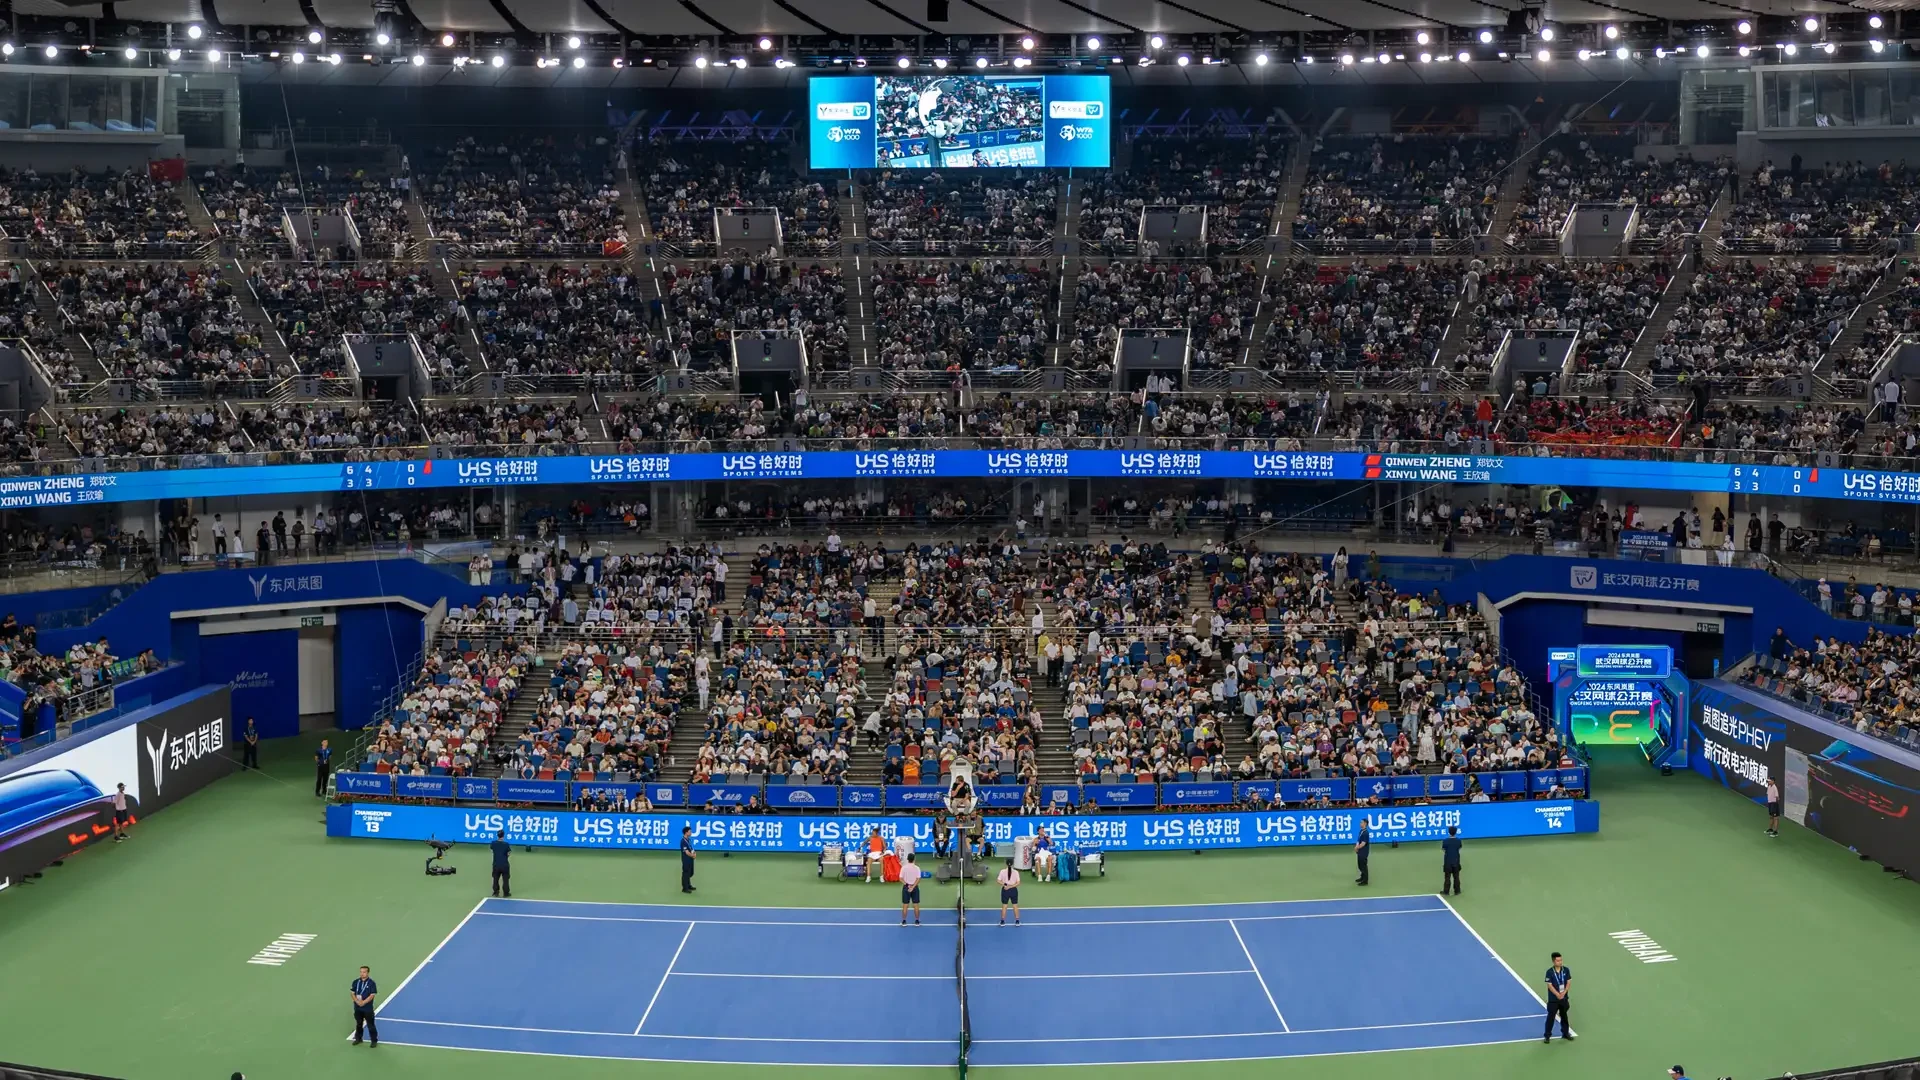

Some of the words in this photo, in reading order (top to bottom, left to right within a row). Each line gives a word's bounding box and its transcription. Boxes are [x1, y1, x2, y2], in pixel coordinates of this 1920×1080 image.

[312, 218, 319, 230] 5
[742, 218, 749, 230] 6
[1172, 216, 1178, 228] 7
[1602, 214, 1609, 227] 8
[375, 346, 382, 361] 5
[763, 342, 771, 355] 6
[1152, 340, 1159, 354] 7
[1538, 342, 1546, 356] 8
[491, 380, 497, 390] 5
[677, 377, 684, 388] 6
[864, 375, 871, 386] 6
[118, 387, 124, 397] 4
[305, 383, 311, 393] 5
[1797, 383, 1804, 393] 9
[783, 440, 790, 451] 6
[1133, 438, 1138, 449] 7
[1480, 443, 1486, 454] 8
[436, 447, 443, 458] 5
[90, 461, 97, 472] 4
[591, 458, 624, 473] UHS
[627, 457, 670, 472] 恰好时
[723, 456, 756, 470] UHS
[759, 455, 802, 469] 恰好时
[855, 454, 889, 468] UHS
[892, 454, 935, 468] 恰好时
[988, 453, 1022, 467] UHS
[1025, 453, 1068, 467] 恰好时
[1121, 453, 1155, 468] UHS
[1157, 454, 1201, 468] 恰好时
[1254, 454, 1288, 469] UHS
[1290, 455, 1333, 470] 恰好时
[1385, 457, 1427, 467] QINWEN
[1430, 457, 1471, 468] ZHENG
[1476, 458, 1504, 469] 郑钦文
[1825, 455, 1831, 466] 9
[347, 465, 353, 474] 6
[364, 465, 372, 474] 4
[407, 464, 414, 473] 0
[459, 461, 492, 477] UHS
[495, 460, 538, 475] 恰好时
[1385, 470, 1417, 479] XINYU
[1420, 469, 1457, 480] WANG
[1463, 470, 1490, 481] 王欣瑜
[1734, 467, 1741, 477] 6
[1752, 468, 1759, 477] 4
[1793, 470, 1800, 480] 0
[0, 481, 41, 494] QINWEN
[44, 477, 84, 489] ZHENG
[90, 476, 117, 487] 郑钦文
[347, 479, 354, 488] 3
[365, 478, 372, 487] 3
[407, 477, 414, 486] 0
[1734, 481, 1741, 490] 3
[1752, 482, 1759, 491] 3
[1793, 484, 1800, 493] 0
[1843, 473, 1876, 490] UHS
[1, 496, 32, 507] XINYU
[35, 492, 71, 504] WANG
[77, 490, 104, 501] 王欣瑜
[270, 576, 323, 593] 东风岚图
[1602, 573, 1700, 591] 武汉网球公开赛
[1607, 683, 1635, 691] 东风岚图
[170, 717, 223, 770] 东风岚图
[1703, 737, 1769, 788] 新行政电动旗舰
[1297, 786, 1332, 796] octagon
[354, 809, 392, 817] CHANGEOVER
[1368, 812, 1407, 830] UHS
[1410, 809, 1461, 828] 恰好时
[365, 821, 380, 832] 13
[464, 813, 504, 832] UHS
[507, 815, 558, 833] 恰好时
[574, 817, 613, 835] UHS
[617, 819, 669, 836] 恰好时
[1143, 819, 1184, 837] UHS
[1187, 818, 1241, 836] 恰好时
[1256, 816, 1297, 834] UHS
[1300, 814, 1352, 832] 恰好时
[1547, 817, 1562, 828] 14
[685, 820, 726, 839] UHS
[729, 820, 783, 839] 恰好时
[799, 821, 840, 839] UHS
[844, 821, 897, 839] 恰好时
[1074, 821, 1127, 838] 恰好时
[507, 834, 558, 842] SYSTEMS
[1257, 834, 1295, 842] SPORT
[1301, 833, 1353, 841] SYSTEMS
[246, 933, 318, 966] WUHAN
[1608, 929, 1678, 963] WUHAN
